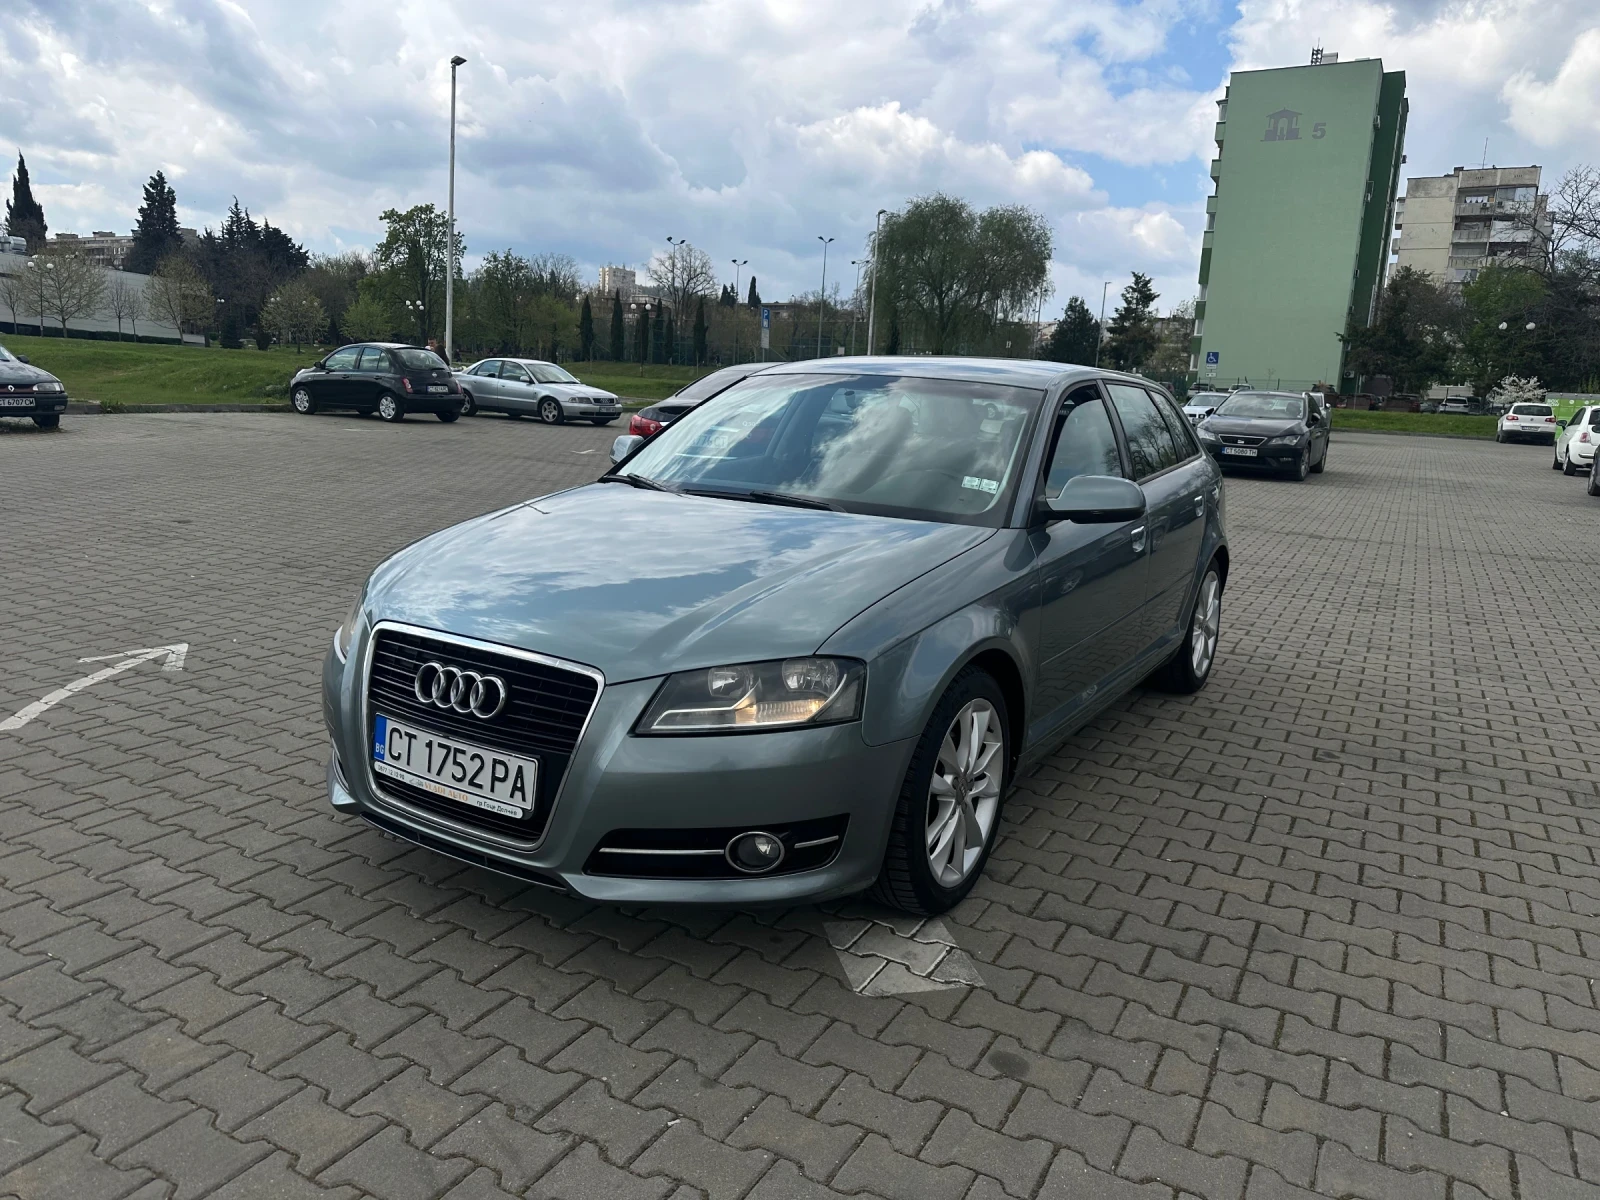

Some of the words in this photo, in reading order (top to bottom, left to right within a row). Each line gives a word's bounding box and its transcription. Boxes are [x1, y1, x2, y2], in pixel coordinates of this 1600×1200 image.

[1311, 121, 1327, 140] 5
[375, 742, 385, 755] BG
[388, 727, 418, 767] CT
[425, 739, 485, 790] 1752
[490, 757, 526, 802] PA
[448, 789, 469, 802] AUTO
